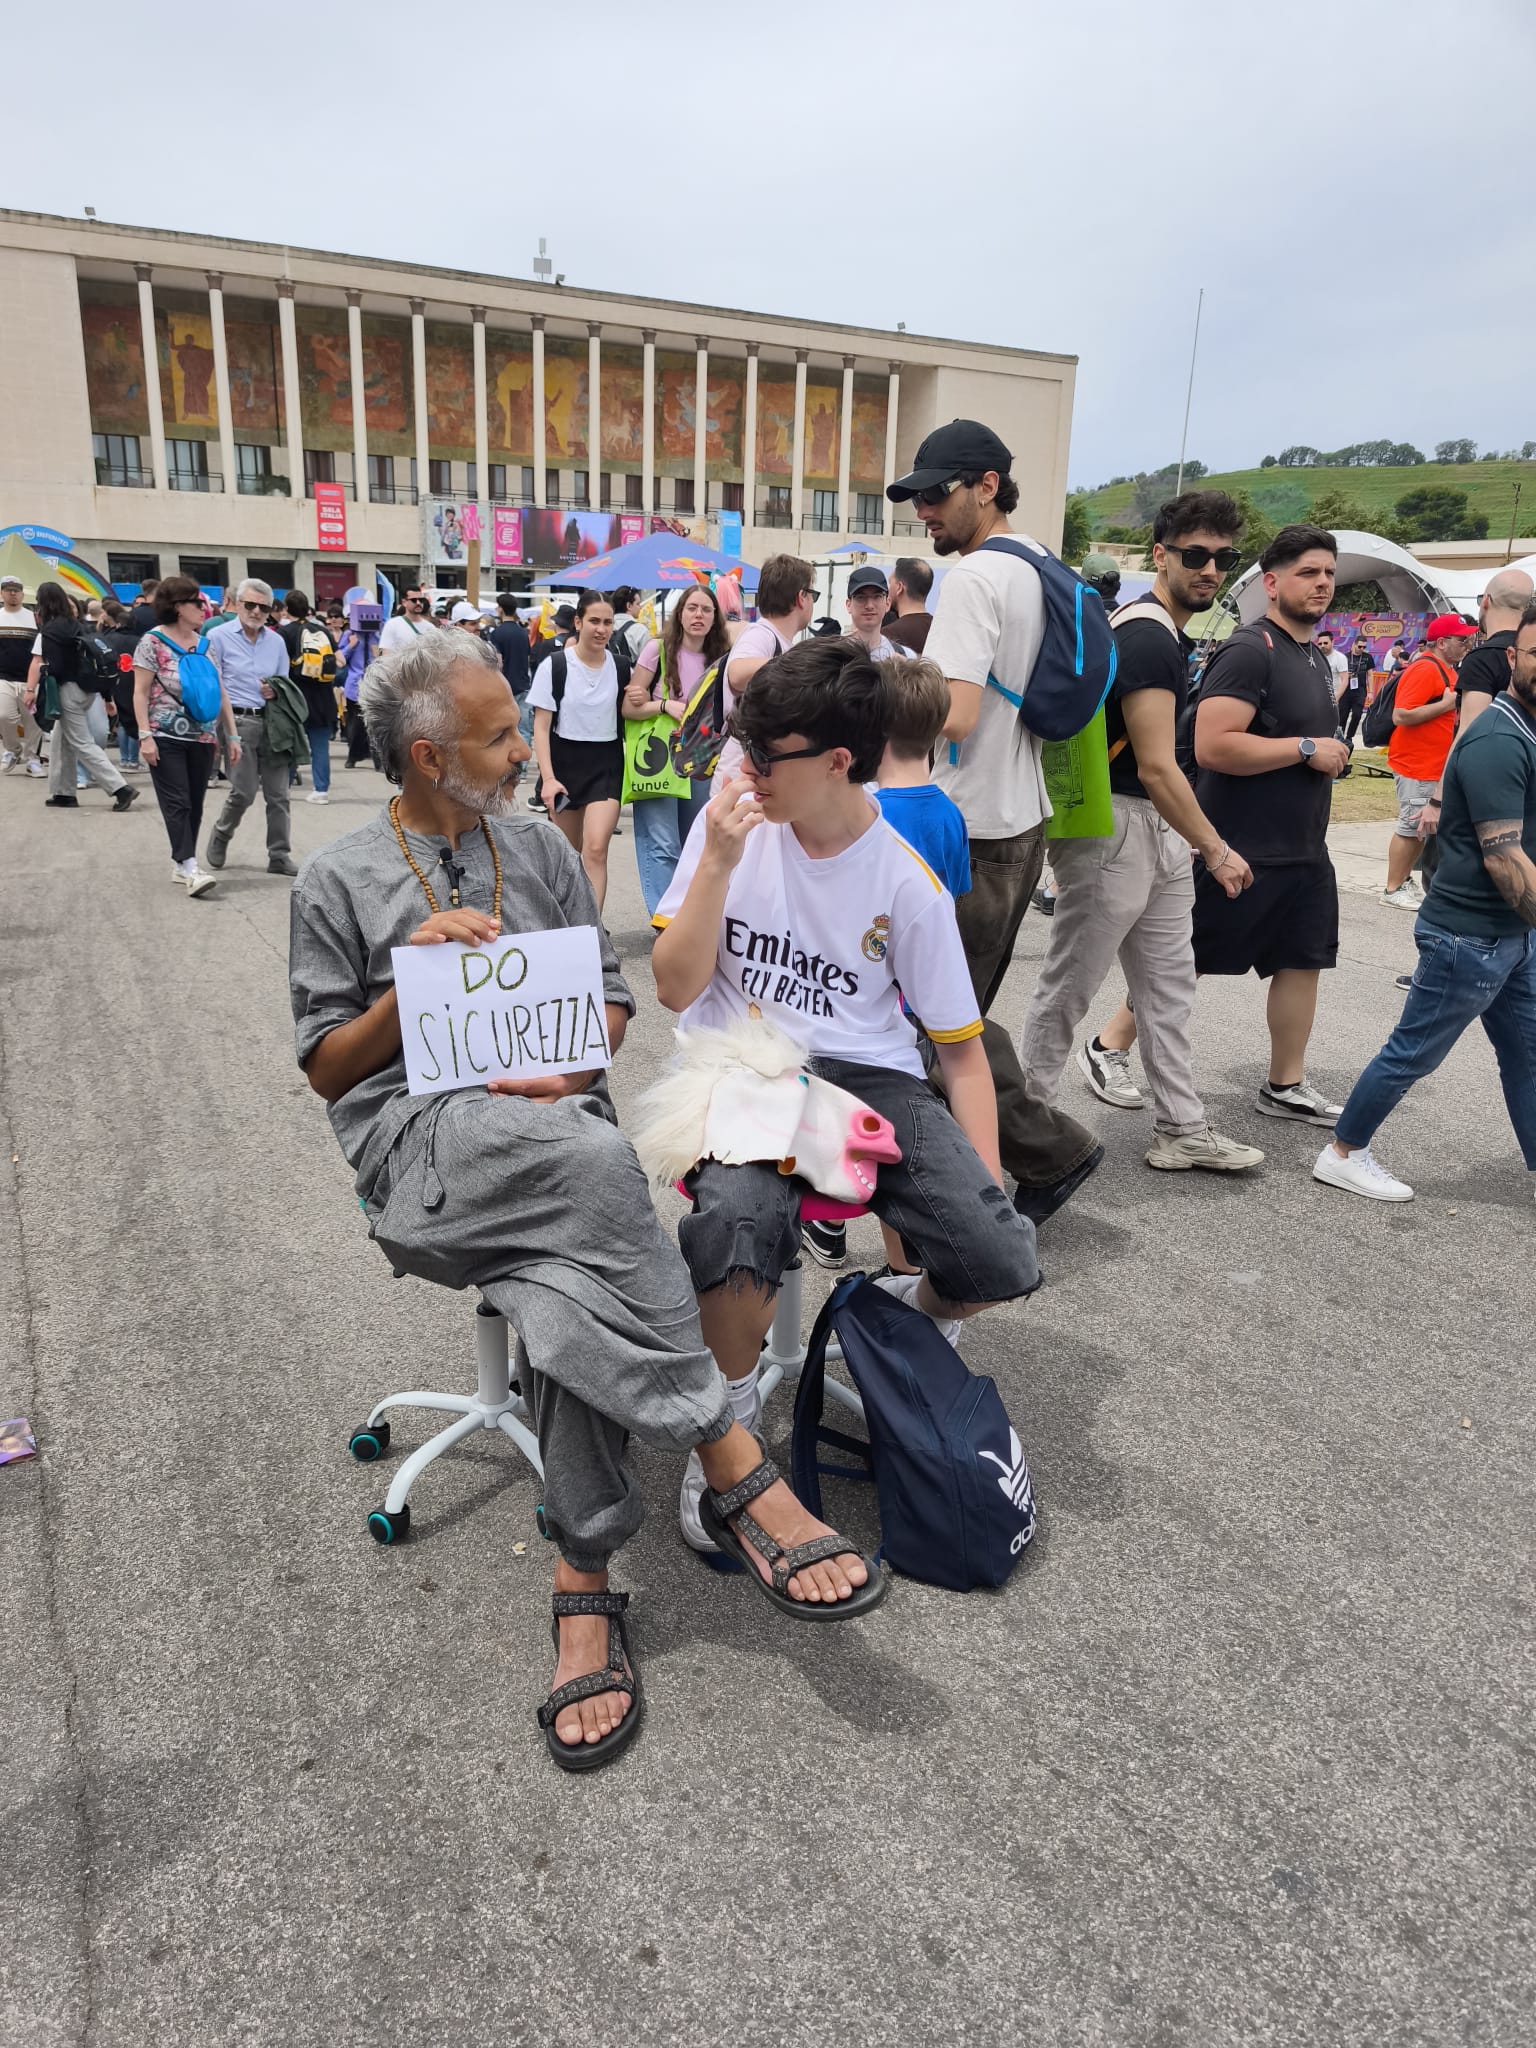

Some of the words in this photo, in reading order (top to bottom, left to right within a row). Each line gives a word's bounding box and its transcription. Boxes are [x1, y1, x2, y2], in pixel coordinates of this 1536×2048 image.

[631, 778, 669, 792] tunué
[461, 948, 528, 993] DO
[741, 967, 771, 999] FLY
